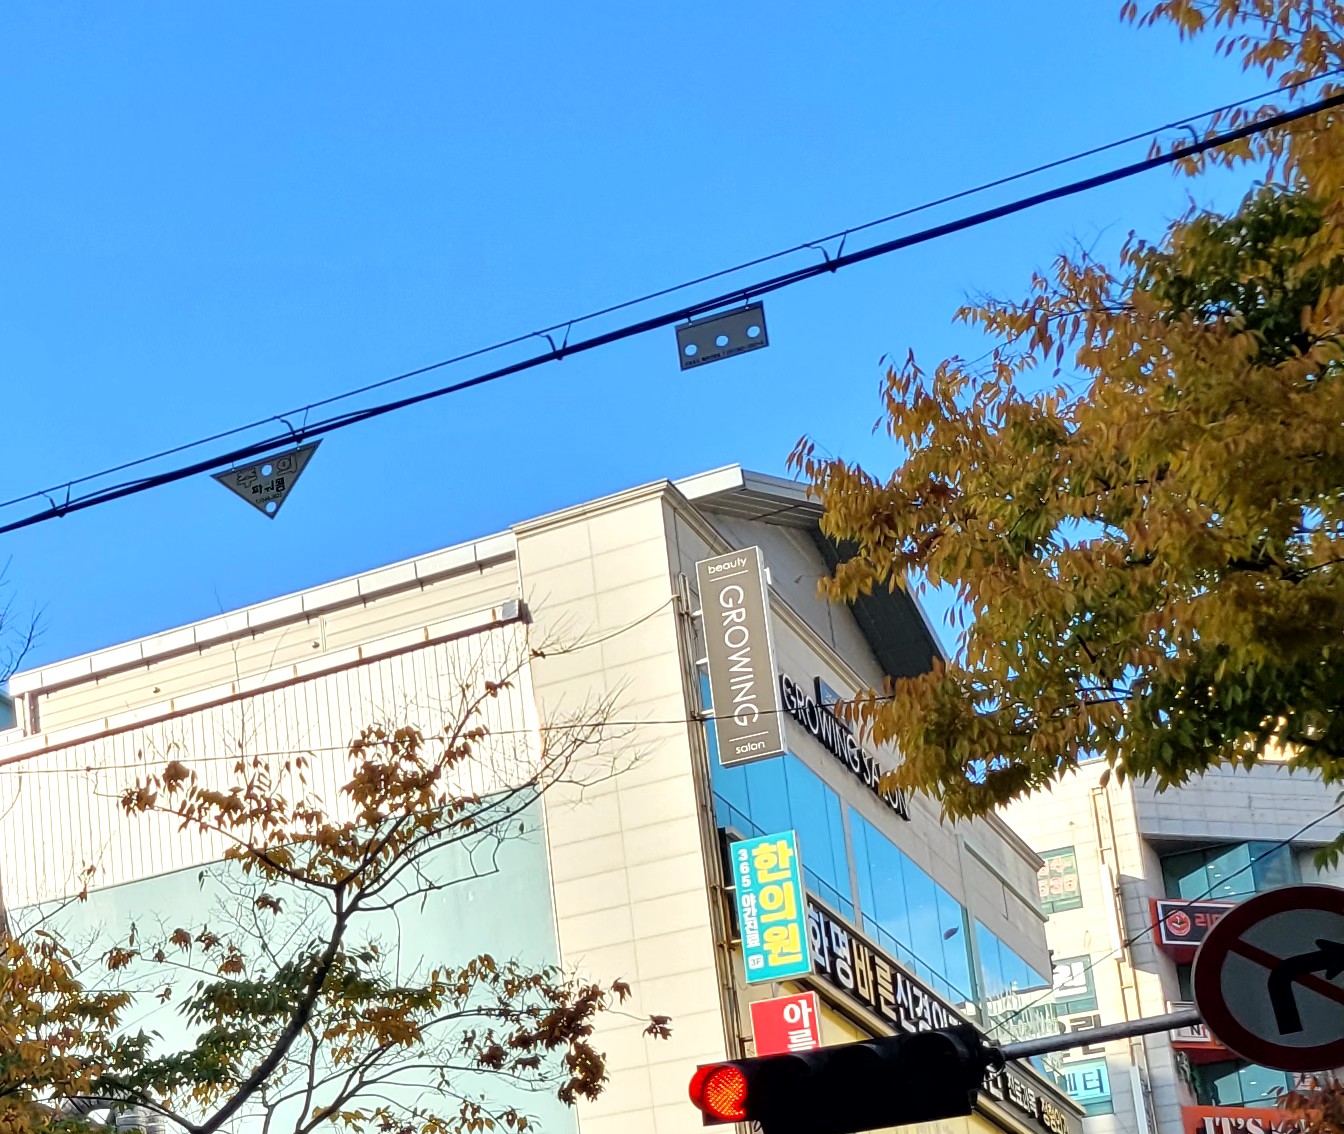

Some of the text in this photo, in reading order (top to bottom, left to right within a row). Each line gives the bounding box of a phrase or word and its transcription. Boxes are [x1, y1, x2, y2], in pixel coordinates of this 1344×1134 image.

[708, 556, 748, 575] beauty
[719, 584, 760, 727] GROWING
[735, 739, 766, 754] salon
[781, 671, 861, 774] GROWING
[737, 848, 752, 888] 365
[752, 839, 803, 967] 한의원
